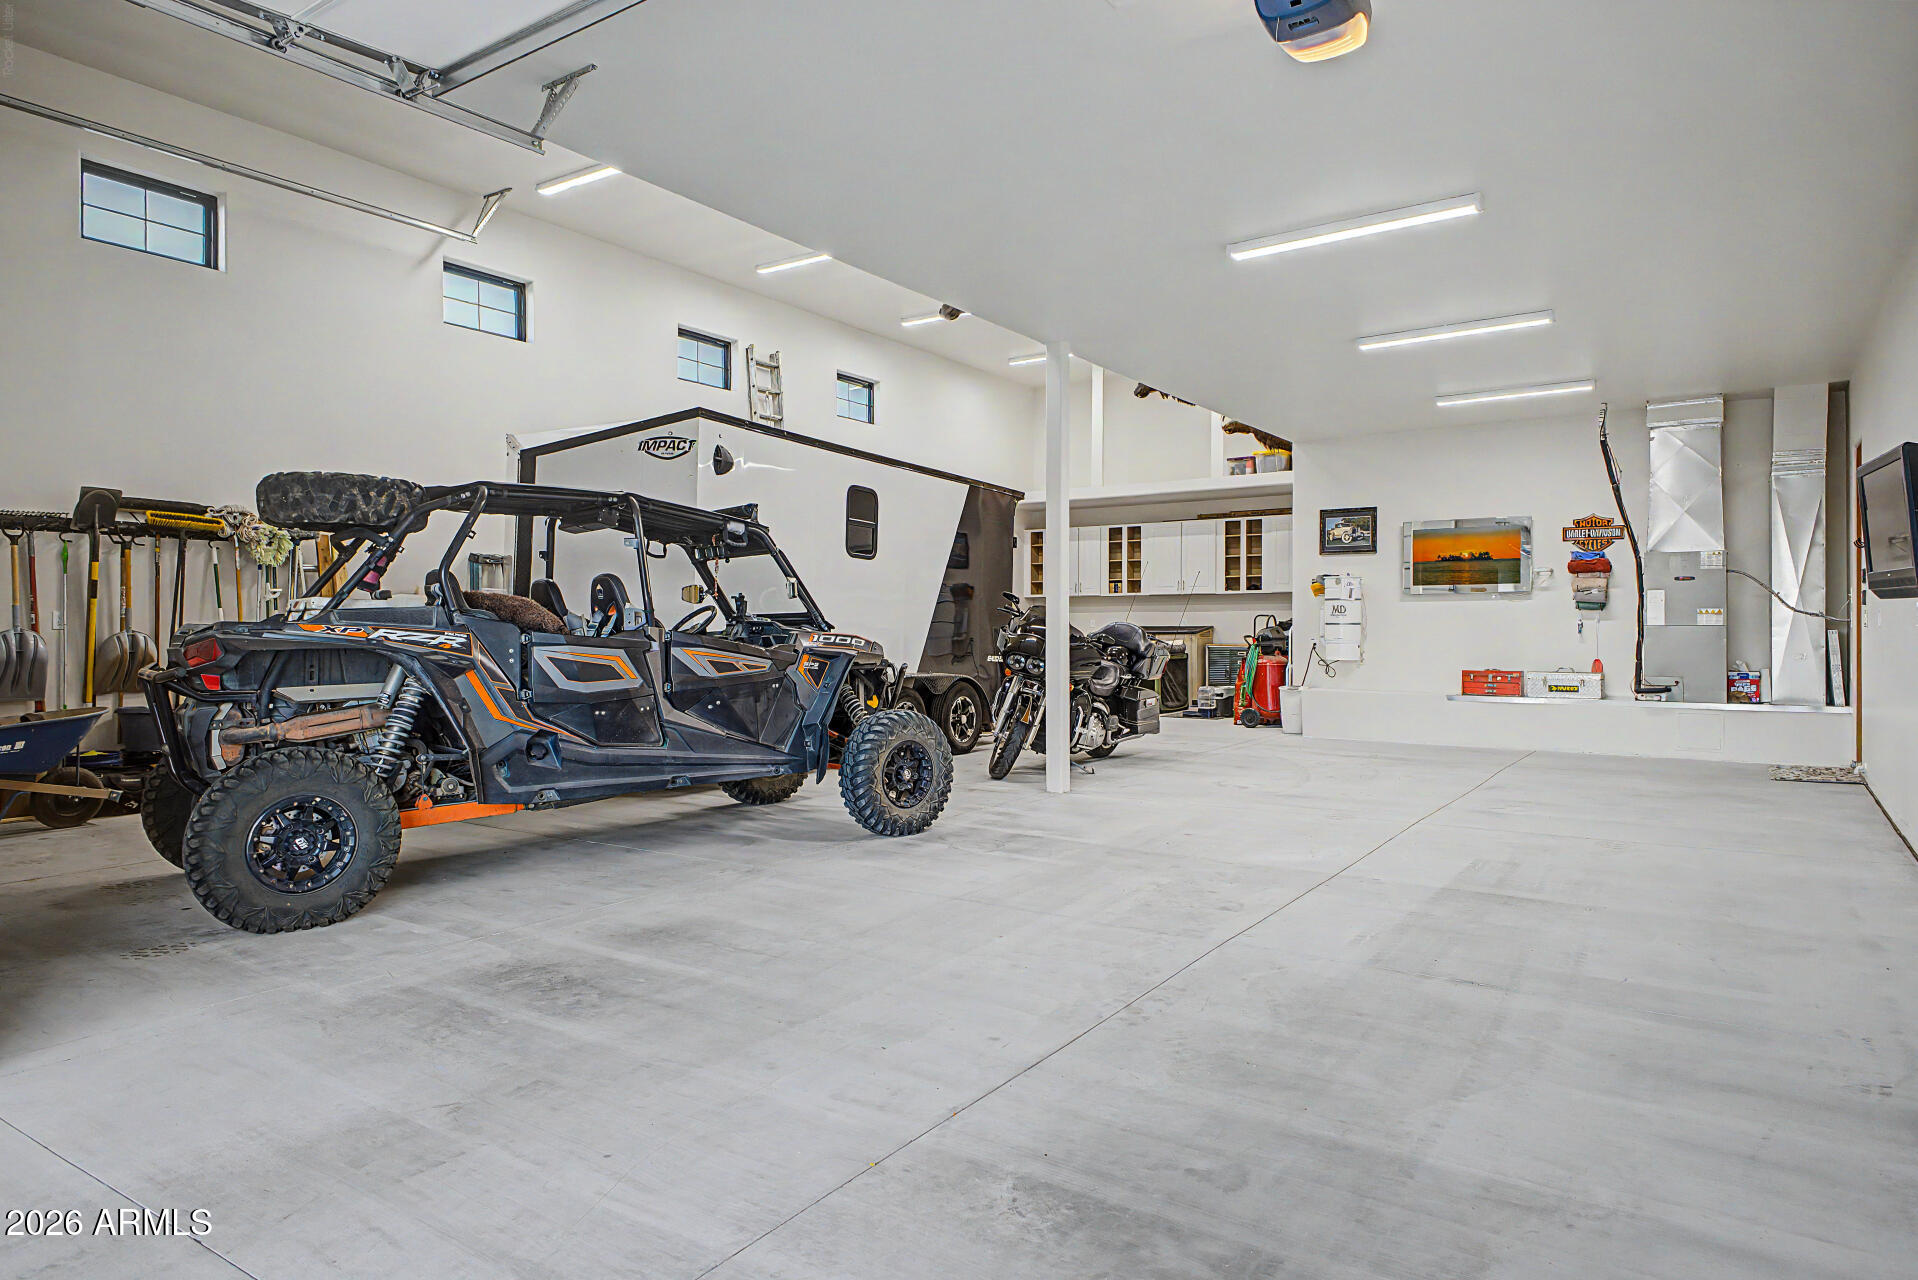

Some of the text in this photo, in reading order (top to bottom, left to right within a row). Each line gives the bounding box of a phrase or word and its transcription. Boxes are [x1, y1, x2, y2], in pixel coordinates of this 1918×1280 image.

[638, 440, 697, 451] IMPACT
[1579, 516, 1609, 527] MOTOR
[323, 625, 363, 634] XP
[368, 628, 467, 649] RZR
[811, 633, 866, 646] 1000
